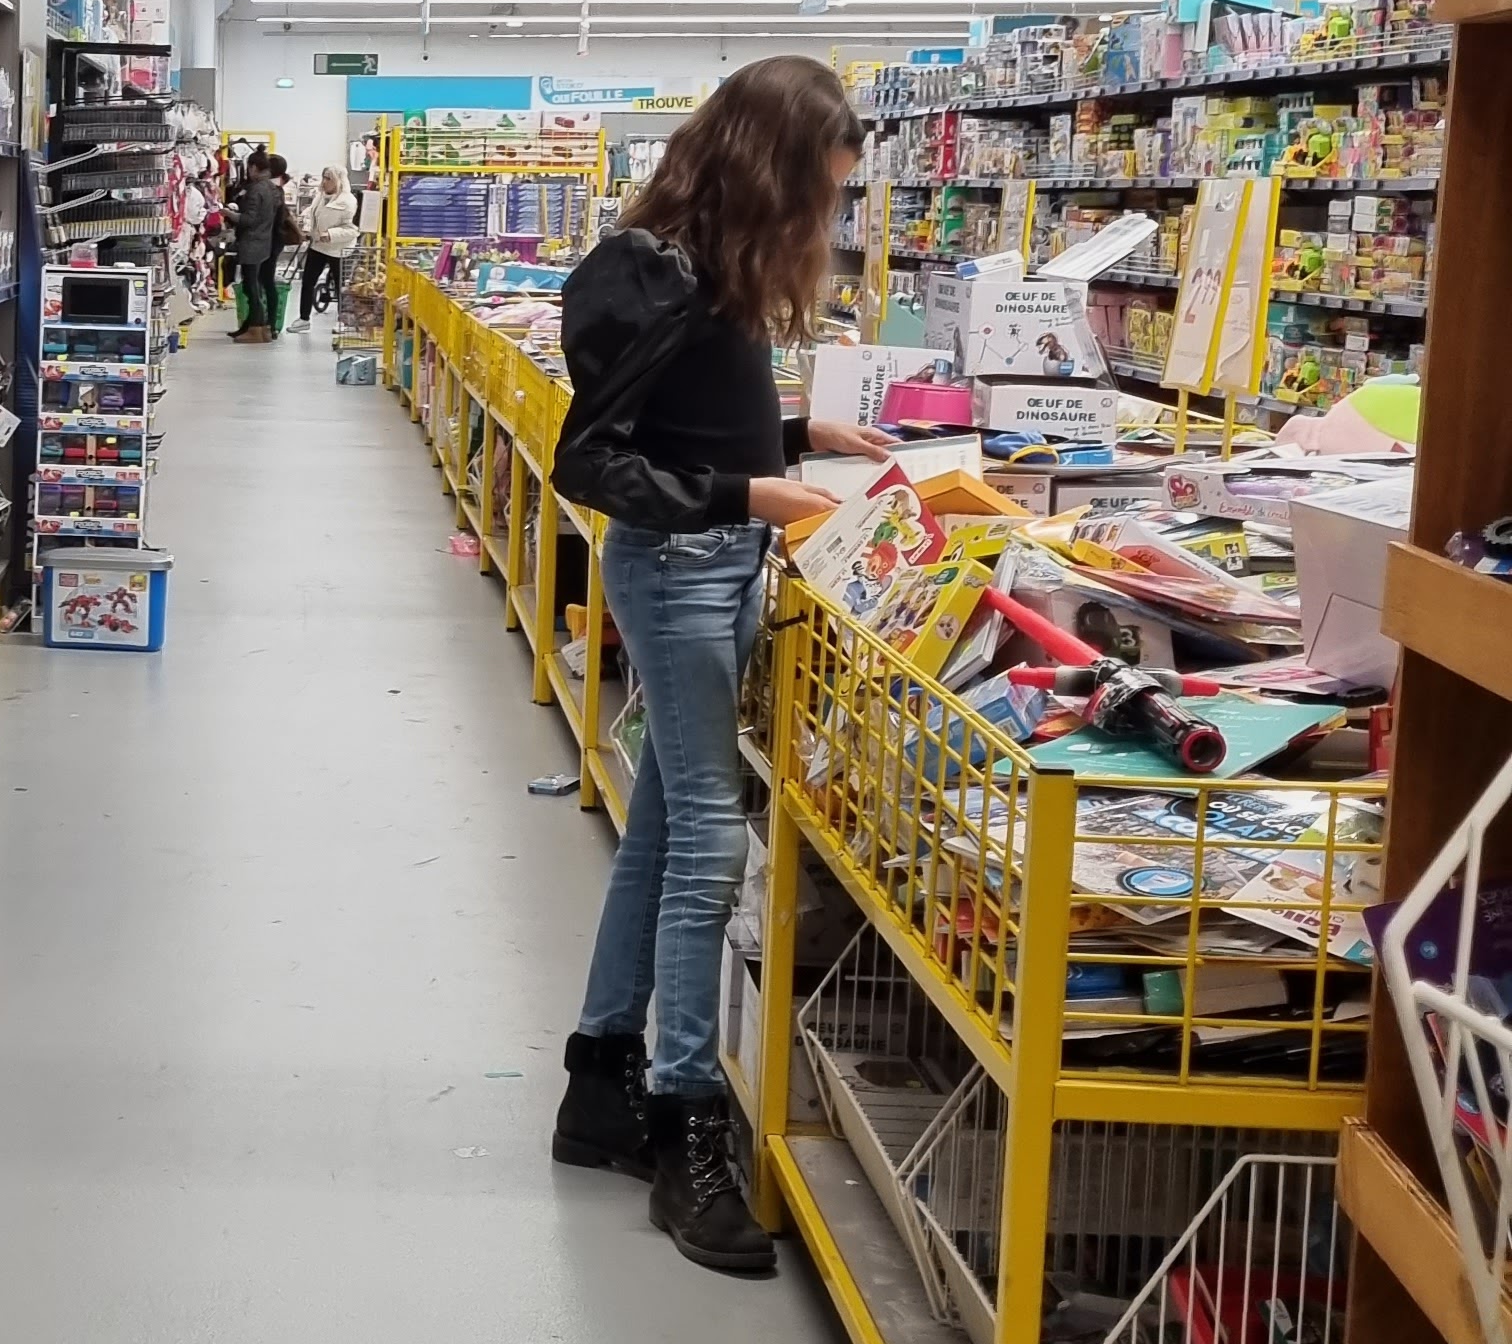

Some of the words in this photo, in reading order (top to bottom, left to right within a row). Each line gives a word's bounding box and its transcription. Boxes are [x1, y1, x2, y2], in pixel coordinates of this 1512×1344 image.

[571, 90, 624, 103] FOUILLE
[637, 96, 694, 110] TROUVE
[1039, 291, 1057, 302] DE
[994, 303, 1069, 315] DINOSAURE
[861, 375, 873, 394] DE
[1065, 398, 1084, 409] DE
[1015, 410, 1097, 423] DINOSAURE
